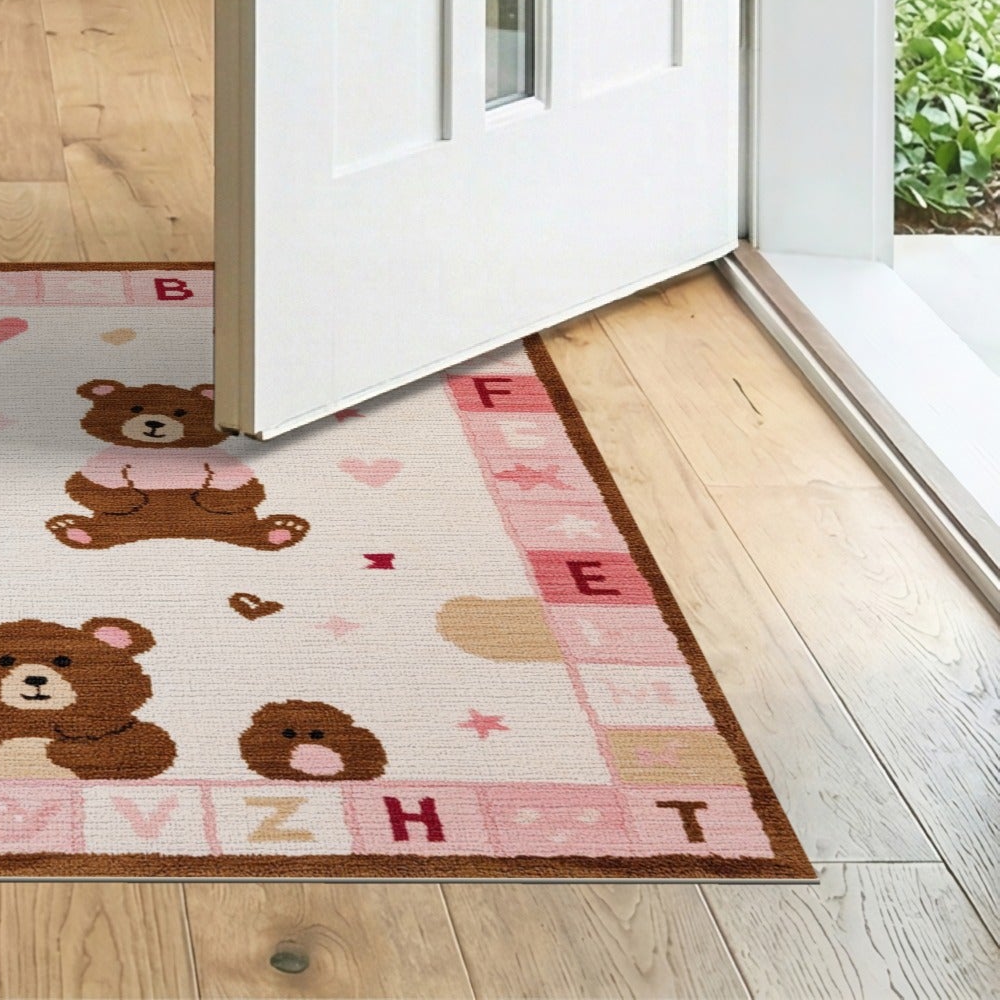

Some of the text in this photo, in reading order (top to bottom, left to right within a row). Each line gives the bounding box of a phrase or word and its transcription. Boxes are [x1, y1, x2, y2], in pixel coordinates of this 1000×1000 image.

[153, 277, 194, 301] B
[472, 377, 513, 408] F
[565, 560, 622, 596] E
[244, 797, 314, 842] Z
[383, 797, 446, 842] H
[656, 801, 708, 844] T
